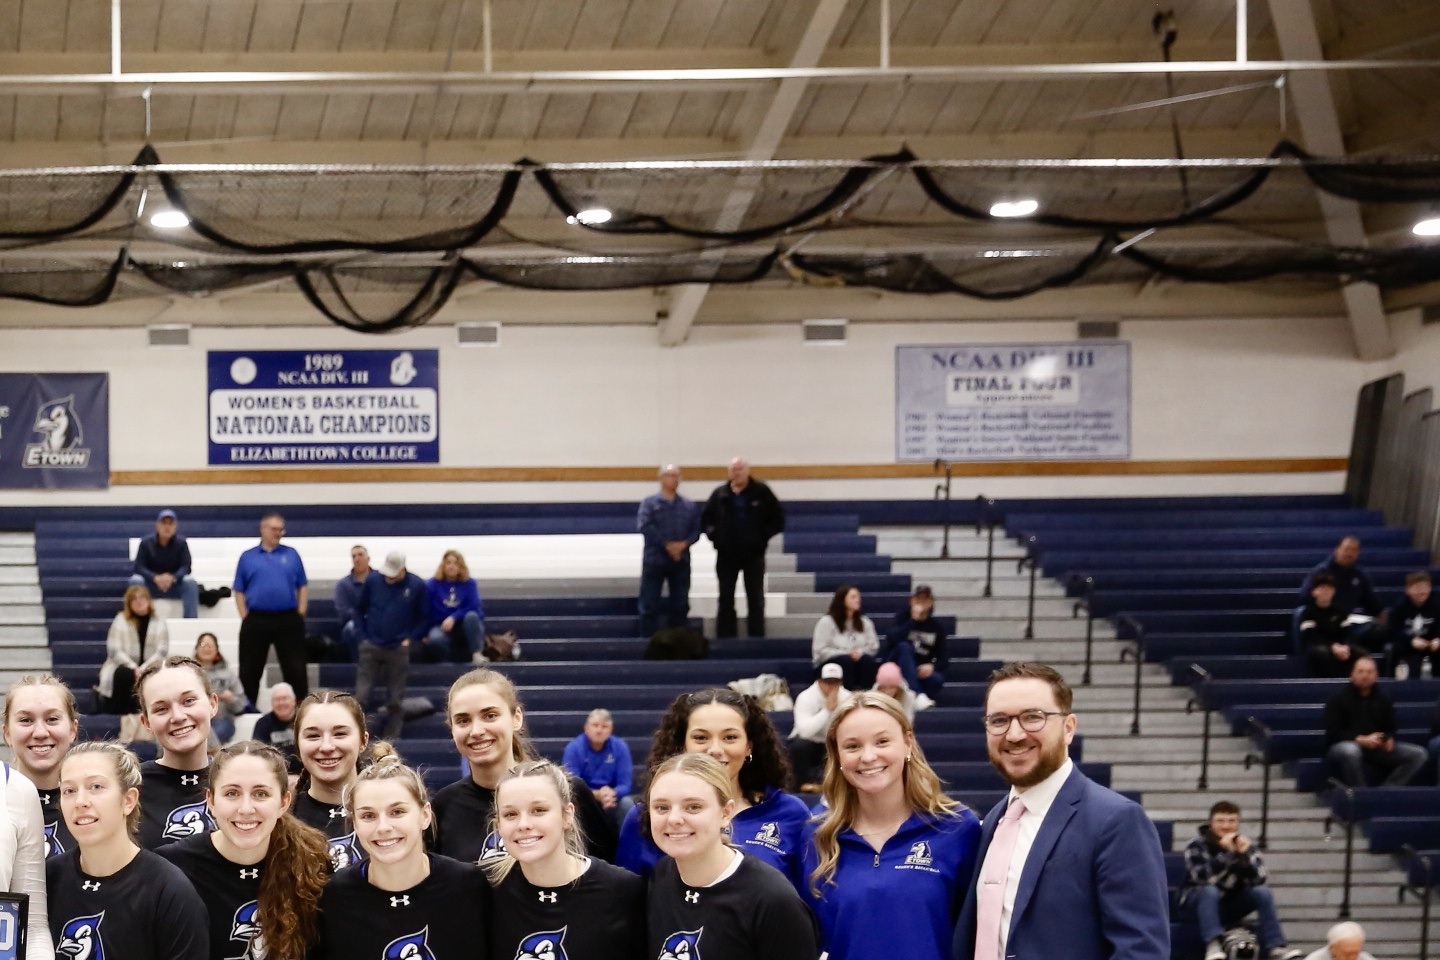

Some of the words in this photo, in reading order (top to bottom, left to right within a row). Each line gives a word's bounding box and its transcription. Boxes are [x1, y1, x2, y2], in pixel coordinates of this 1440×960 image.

[304, 354, 344, 371] 1989
[931, 350, 1003, 370] NCAA
[1066, 350, 1096, 368] III
[277, 371, 318, 385] NCAA
[321, 371, 348, 384] DIV.
[351, 370, 369, 384] III
[951, 375, 1014, 391] FINAL
[228, 396, 306, 410] WOMEN'S
[312, 395, 420, 409] BASKETBALL
[216, 416, 314, 434] NATIONAL
[319, 414, 432, 434] CHAMPIONS
[230, 447, 349, 461] ELIZABETHTOWN
[351, 446, 417, 460] COLLEGE
